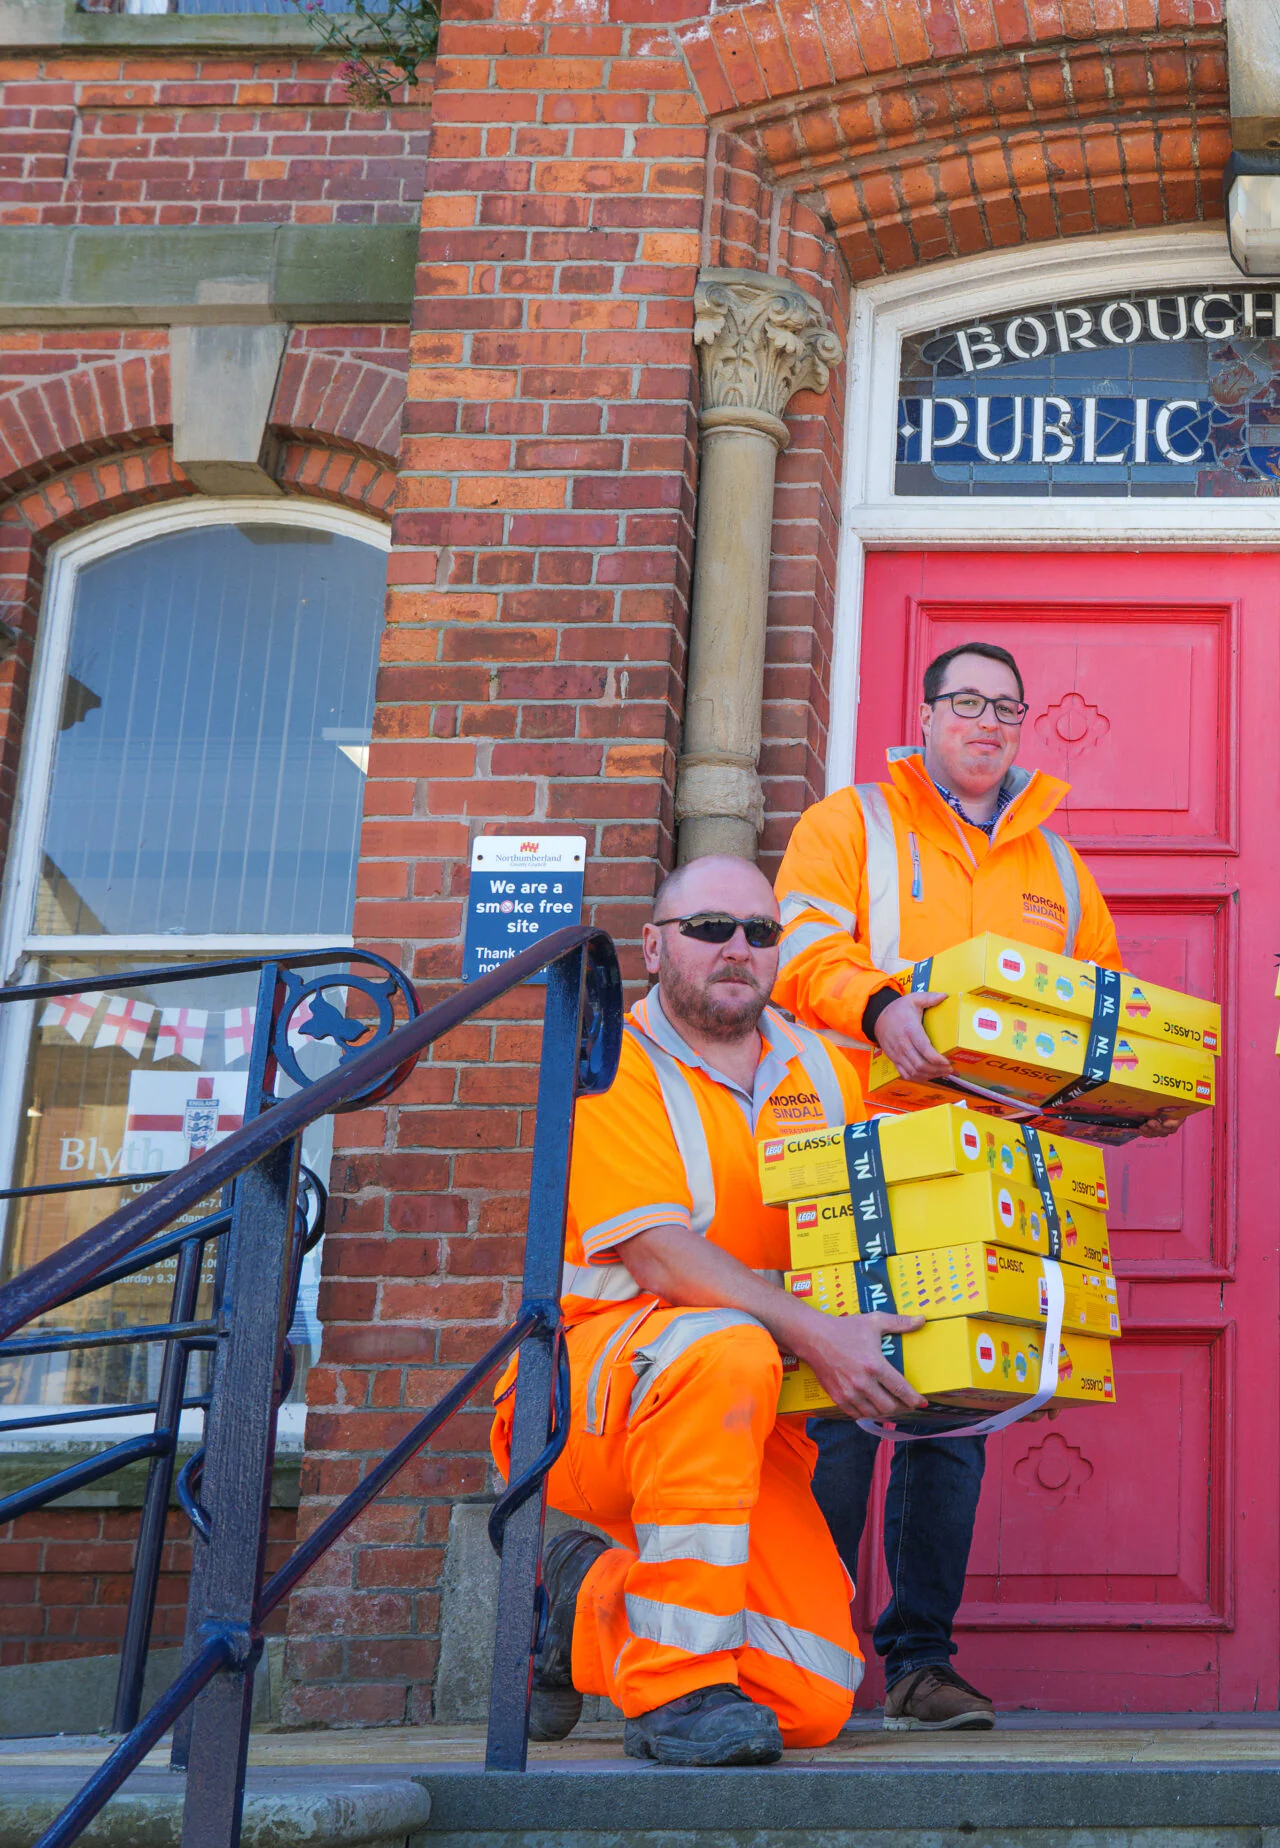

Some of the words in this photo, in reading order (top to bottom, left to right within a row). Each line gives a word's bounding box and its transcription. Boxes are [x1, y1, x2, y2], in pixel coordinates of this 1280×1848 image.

[919, 397, 1204, 464] PUBLIC
[495, 853, 562, 862] Northumberland
[490, 880, 516, 894] We
[520, 883, 548, 894] are
[553, 883, 563, 894] a
[539, 900, 574, 913] free
[1022, 892, 1065, 915] MORGAN
[1023, 902, 1065, 924] SINDALL
[507, 919, 539, 933] site
[475, 948, 516, 959] Thank
[1102, 995, 1115, 1017] NL
[1095, 1035, 1110, 1058] NL
[769, 1092, 821, 1107] MORGAN
[764, 1144, 783, 1157] LEGO
[787, 1133, 841, 1153] CLASSIC
[59, 1136, 164, 1179] Blyth
[853, 1150, 873, 1180] NL
[796, 1210, 817, 1223] LEGO
[821, 1203, 854, 1220] CLAS
[859, 1191, 880, 1221] NL
[792, 1280, 811, 1291] LEGO
[868, 1283, 889, 1312] NL
